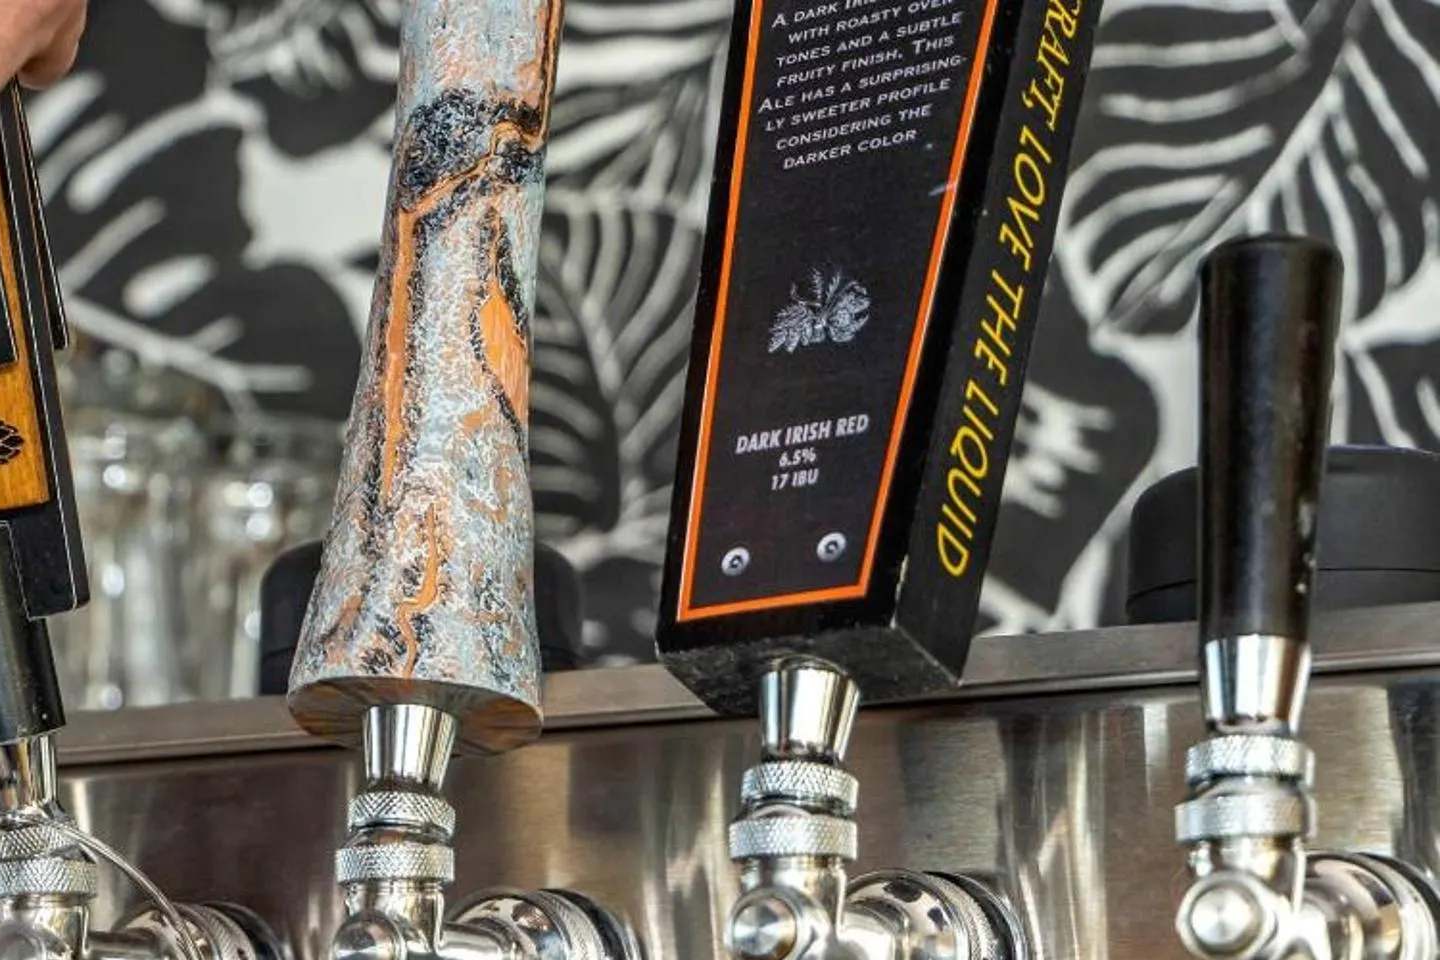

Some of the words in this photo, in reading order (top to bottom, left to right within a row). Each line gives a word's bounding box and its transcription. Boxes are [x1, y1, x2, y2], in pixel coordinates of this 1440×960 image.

[771, 13, 788, 29] A
[793, 4, 838, 23] DARK
[776, 45, 831, 67] TONES
[836, 35, 873, 53] AND
[878, 31, 890, 43] A
[896, 11, 965, 38] SUBTLE
[788, 24, 830, 45] WITH
[836, 6, 903, 32] ROASTY
[758, 95, 795, 114] ALE
[801, 85, 835, 103] HAS
[841, 81, 853, 94] A
[858, 55, 968, 89] SURPRISING-
[776, 65, 835, 88] FRUITY
[841, 50, 904, 73] FINISH.
[911, 35, 955, 55] THIS
[765, 118, 785, 132] LY
[790, 98, 871, 127] SWEETER
[876, 78, 952, 105] PROFILE
[776, 116, 893, 151] CONSIDERING
[898, 104, 935, 120] THE
[783, 146, 852, 171] DARKER
[857, 129, 919, 153] COLOR
[999, 124, 1052, 272] LOVE
[975, 268, 1025, 385] THE
[735, 432, 781, 455] DARK
[784, 420, 832, 444] IRISH
[835, 414, 869, 436] RED
[778, 449, 817, 468] 6.5%
[770, 473, 789, 491] 17
[792, 468, 820, 488] IBU
[937, 378, 999, 577] LIQUID
